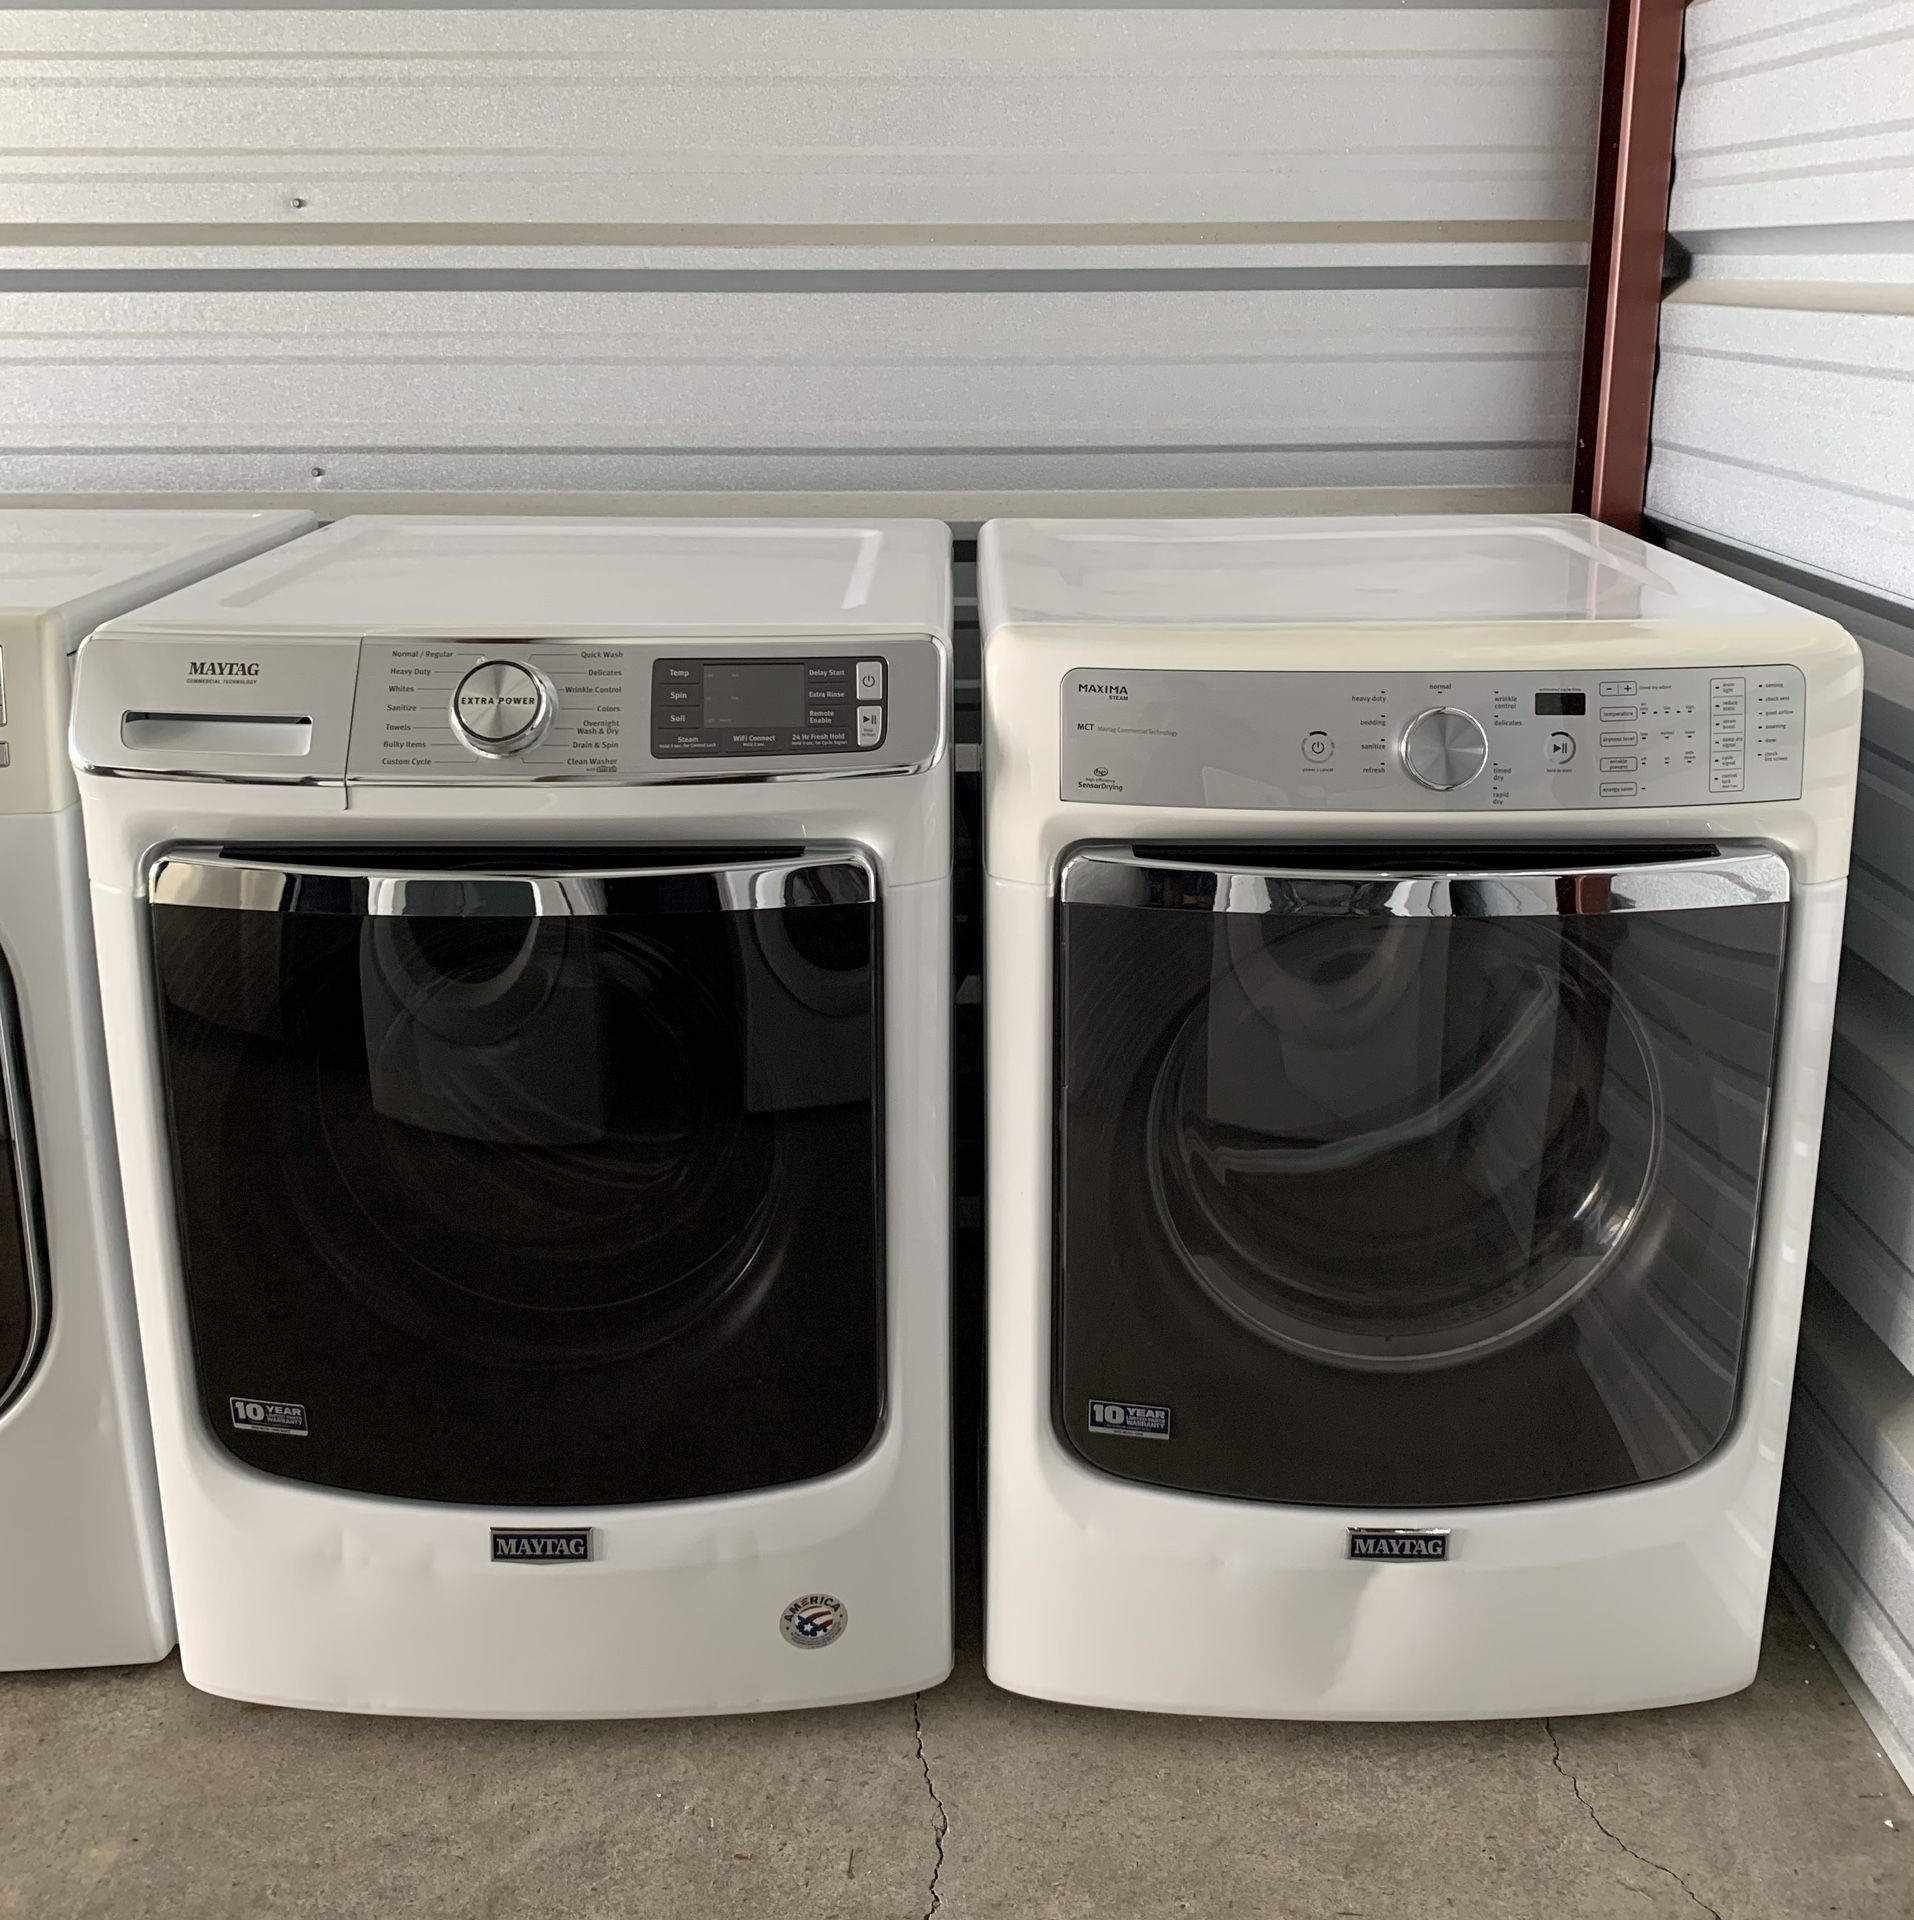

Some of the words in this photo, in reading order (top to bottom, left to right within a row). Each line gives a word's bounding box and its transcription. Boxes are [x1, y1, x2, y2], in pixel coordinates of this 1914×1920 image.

[426, 651, 453, 660] Regular
[580, 651, 601, 659] Quick
[188, 661, 260, 676] MAYTAG
[390, 668, 413, 676] Heavy
[414, 668, 431, 676] Duty
[670, 669, 690, 677] Temp
[809, 669, 828, 677] Delay
[1078, 683, 1128, 695] MAXIMA
[670, 691, 688, 700] Spin
[461, 697, 494, 705] EXTRA
[498, 697, 535, 705] POWER
[583, 719, 619, 728] Overnight
[1077, 723, 1095, 731] MCT
[606, 728, 619, 736] Dry
[383, 741, 404, 749] Bulky
[602, 742, 619, 750] Spin
[411, 758, 431, 766] Cycle
[1078, 781, 1123, 792] SensorDrying
[1493, 791, 1510, 799] rapid
[235, 1401, 265, 1421] 10
[265, 1405, 301, 1416] YEAR
[1093, 1404, 1125, 1425] 10
[1127, 1407, 1165, 1419] YEAR
[496, 1538, 585, 1555] MAYTAG
[1354, 1538, 1443, 1555] MAYTAG
[784, 1596, 840, 1623] AMERICA
